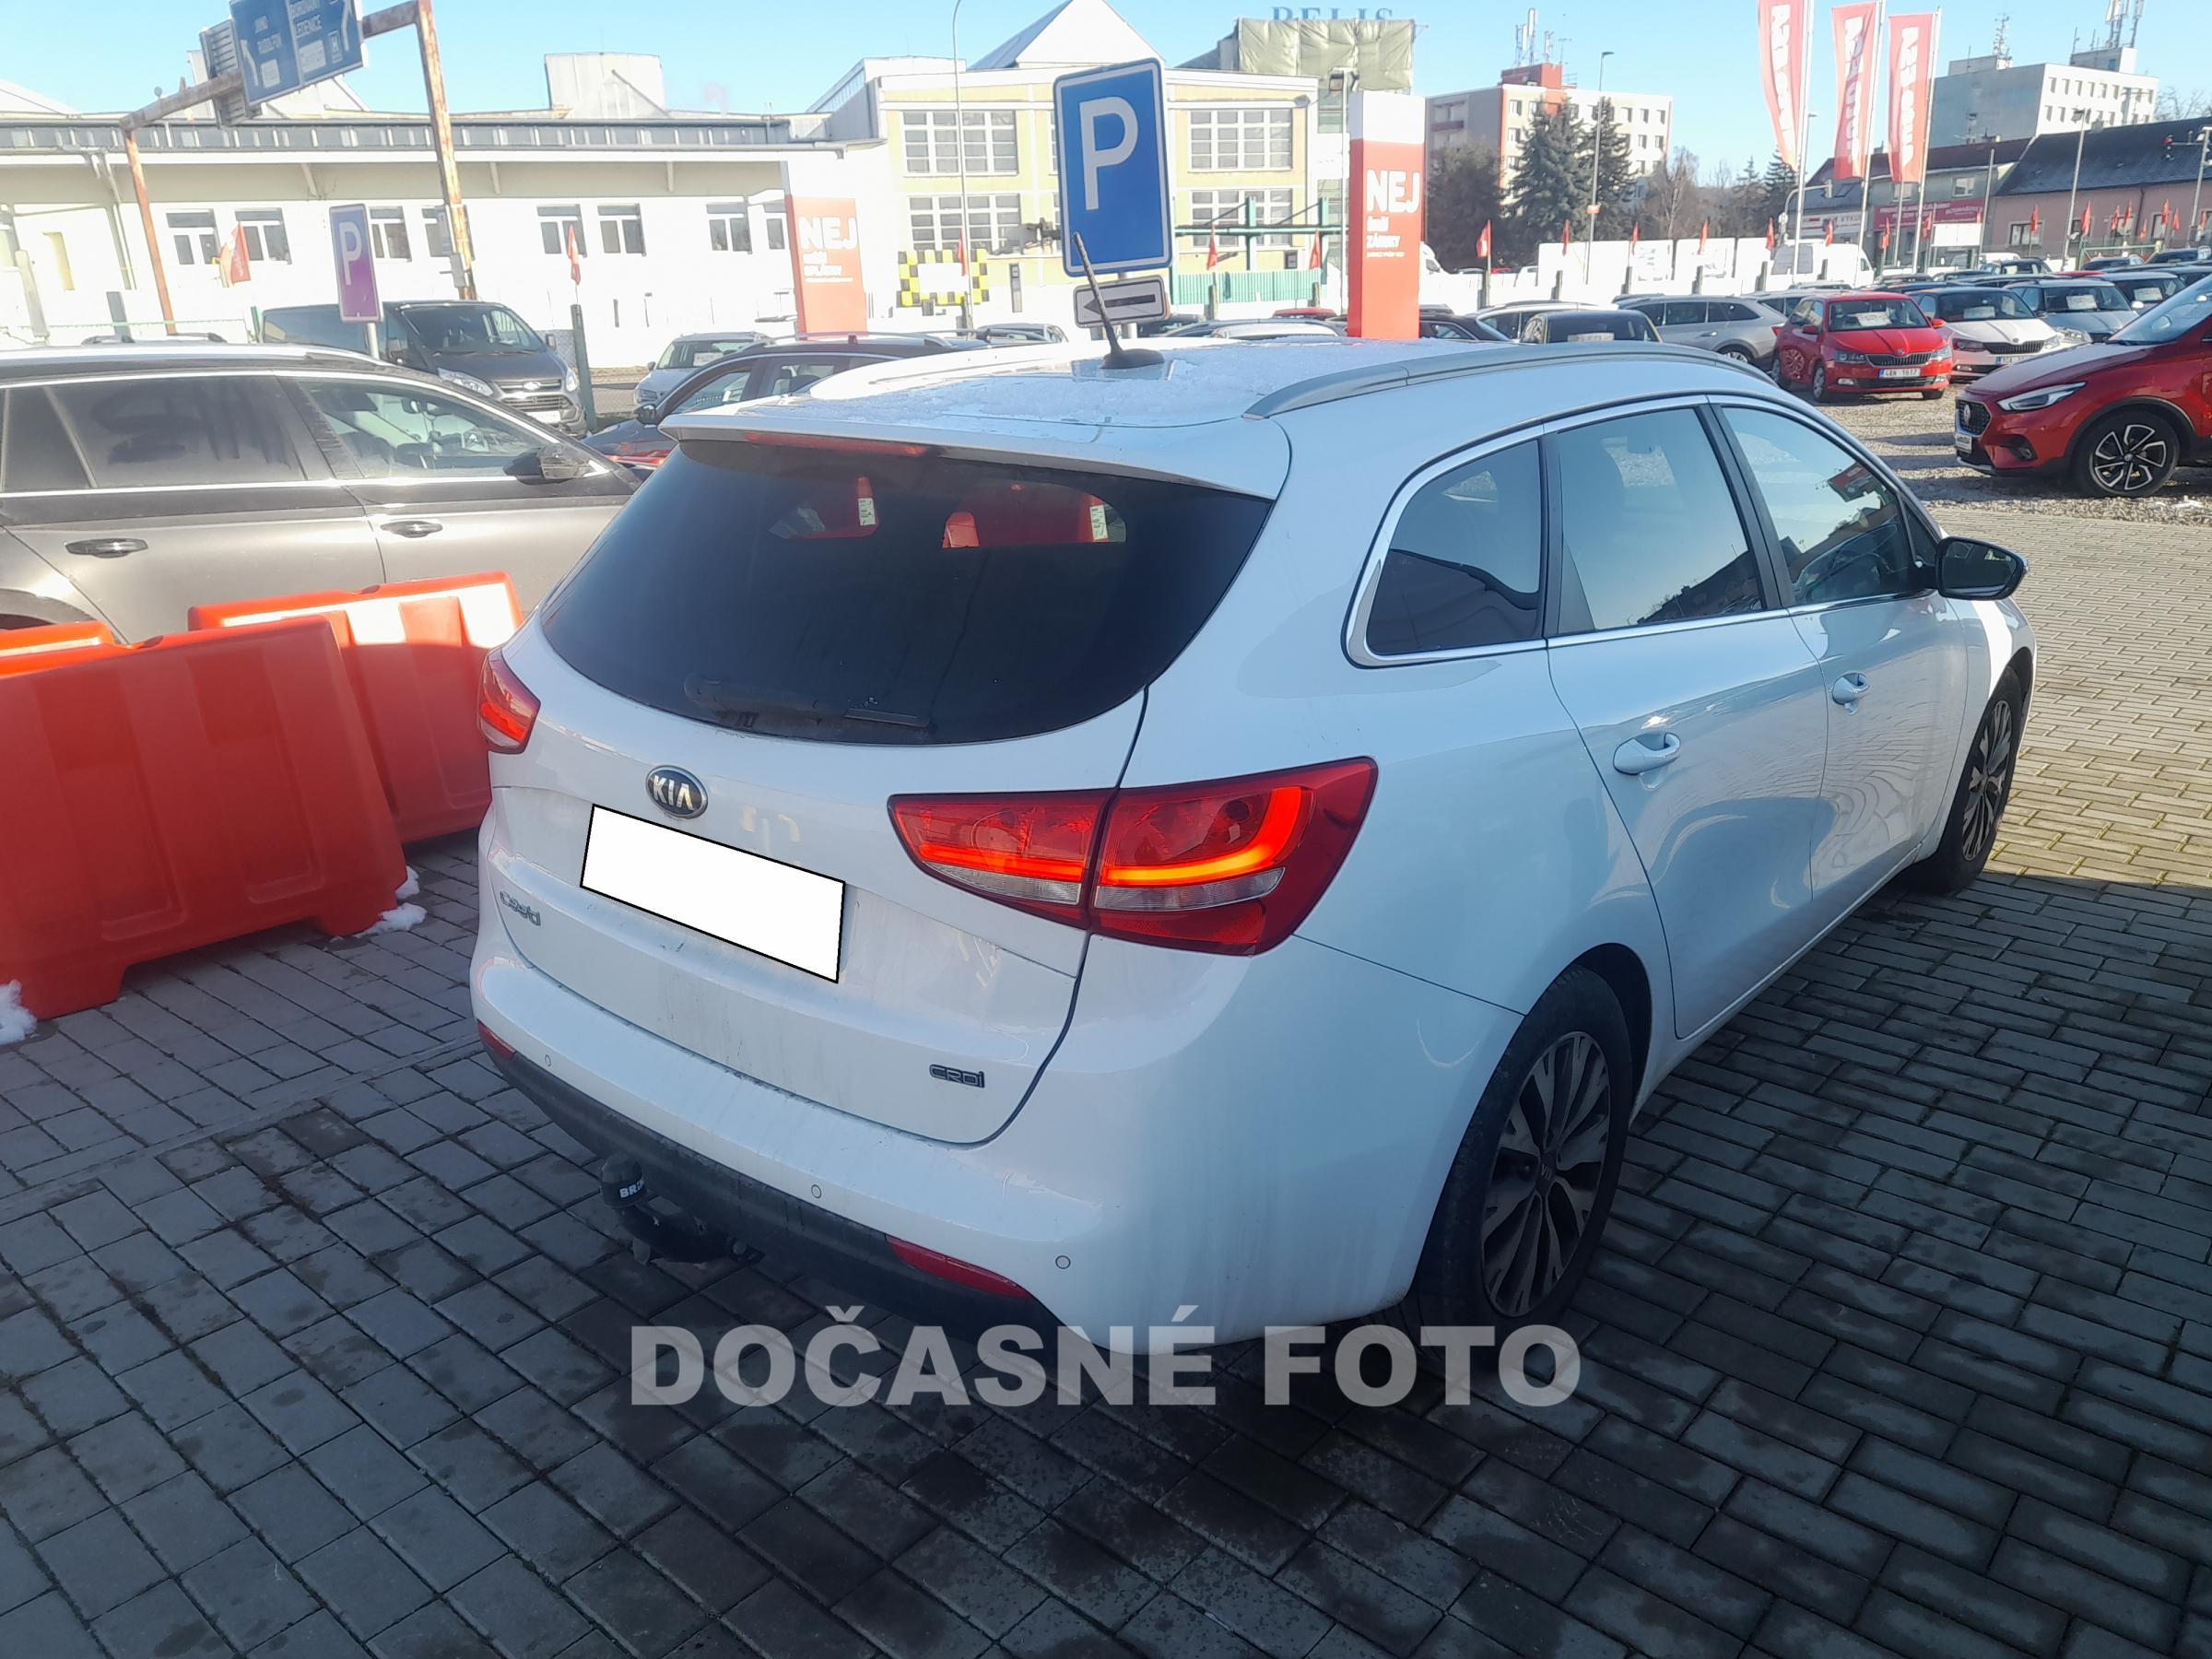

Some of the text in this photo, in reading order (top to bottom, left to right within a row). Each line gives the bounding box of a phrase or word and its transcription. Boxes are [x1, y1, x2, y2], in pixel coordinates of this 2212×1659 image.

[1079, 96, 1139, 211] P
[1366, 169, 1420, 214] NEJ
[338, 221, 362, 286] P
[798, 216, 858, 250] NEJ
[652, 774, 695, 811] KIA
